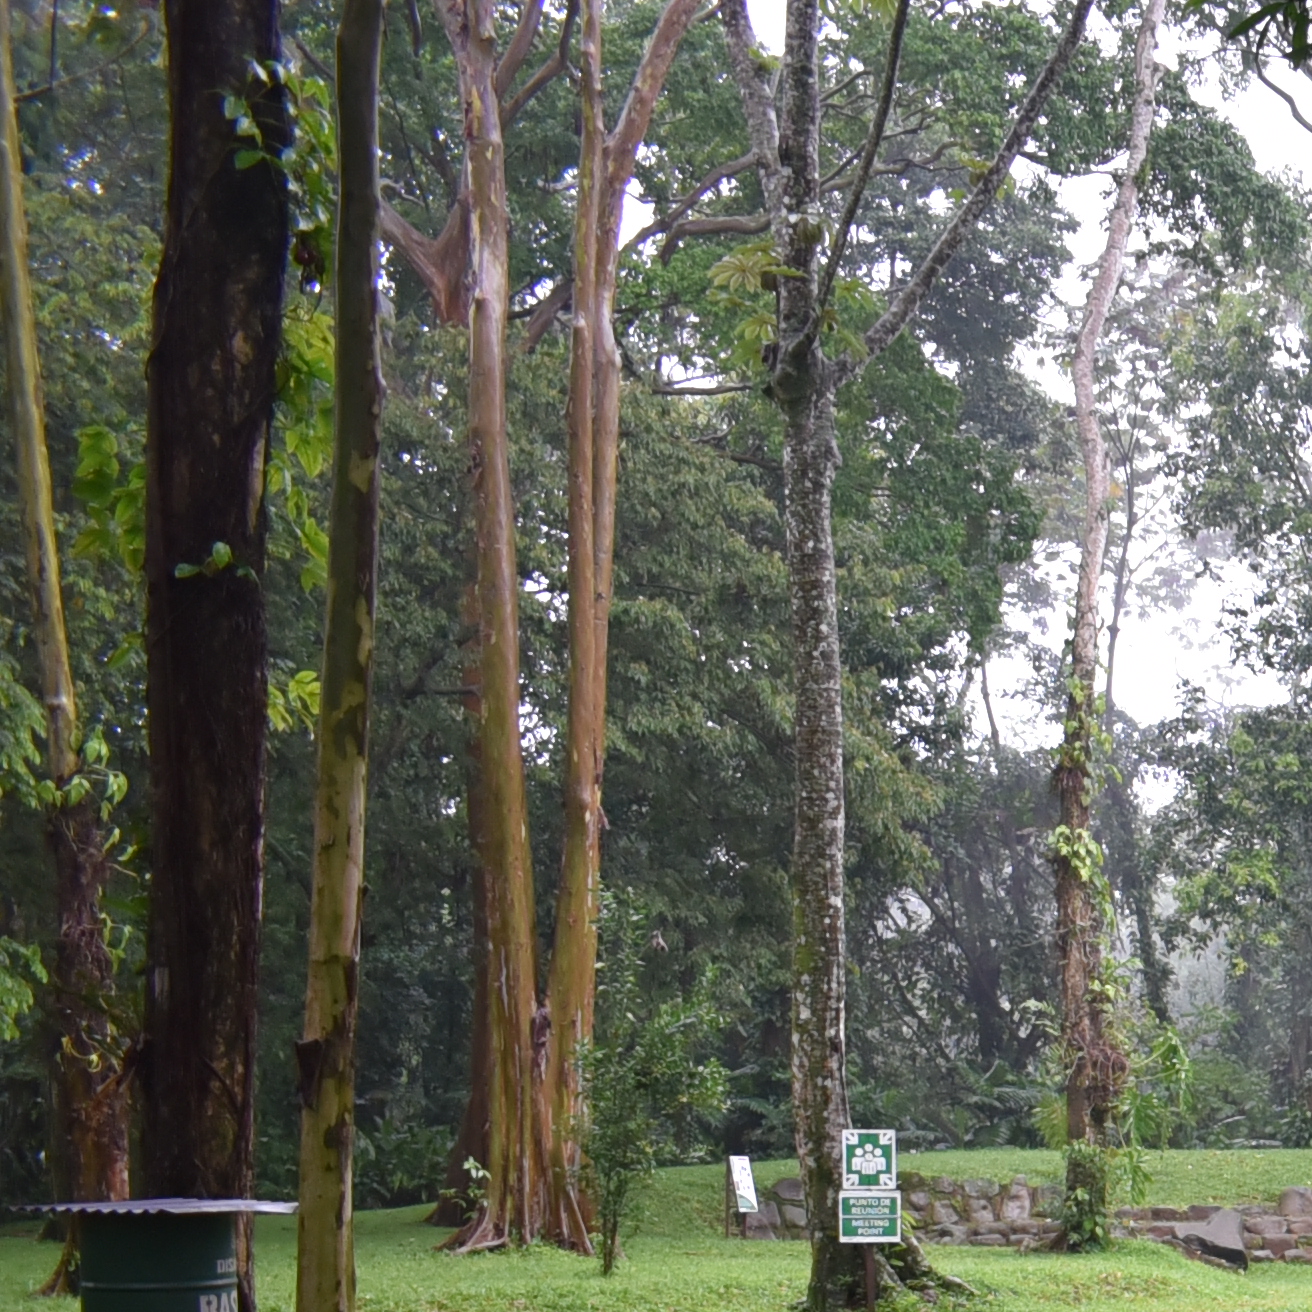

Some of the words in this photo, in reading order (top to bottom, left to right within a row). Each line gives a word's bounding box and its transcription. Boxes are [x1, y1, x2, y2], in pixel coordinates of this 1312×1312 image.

[849, 1198, 879, 1206] PUNTO
[880, 1198, 891, 1206] DE
[857, 1227, 884, 1236] POINT
